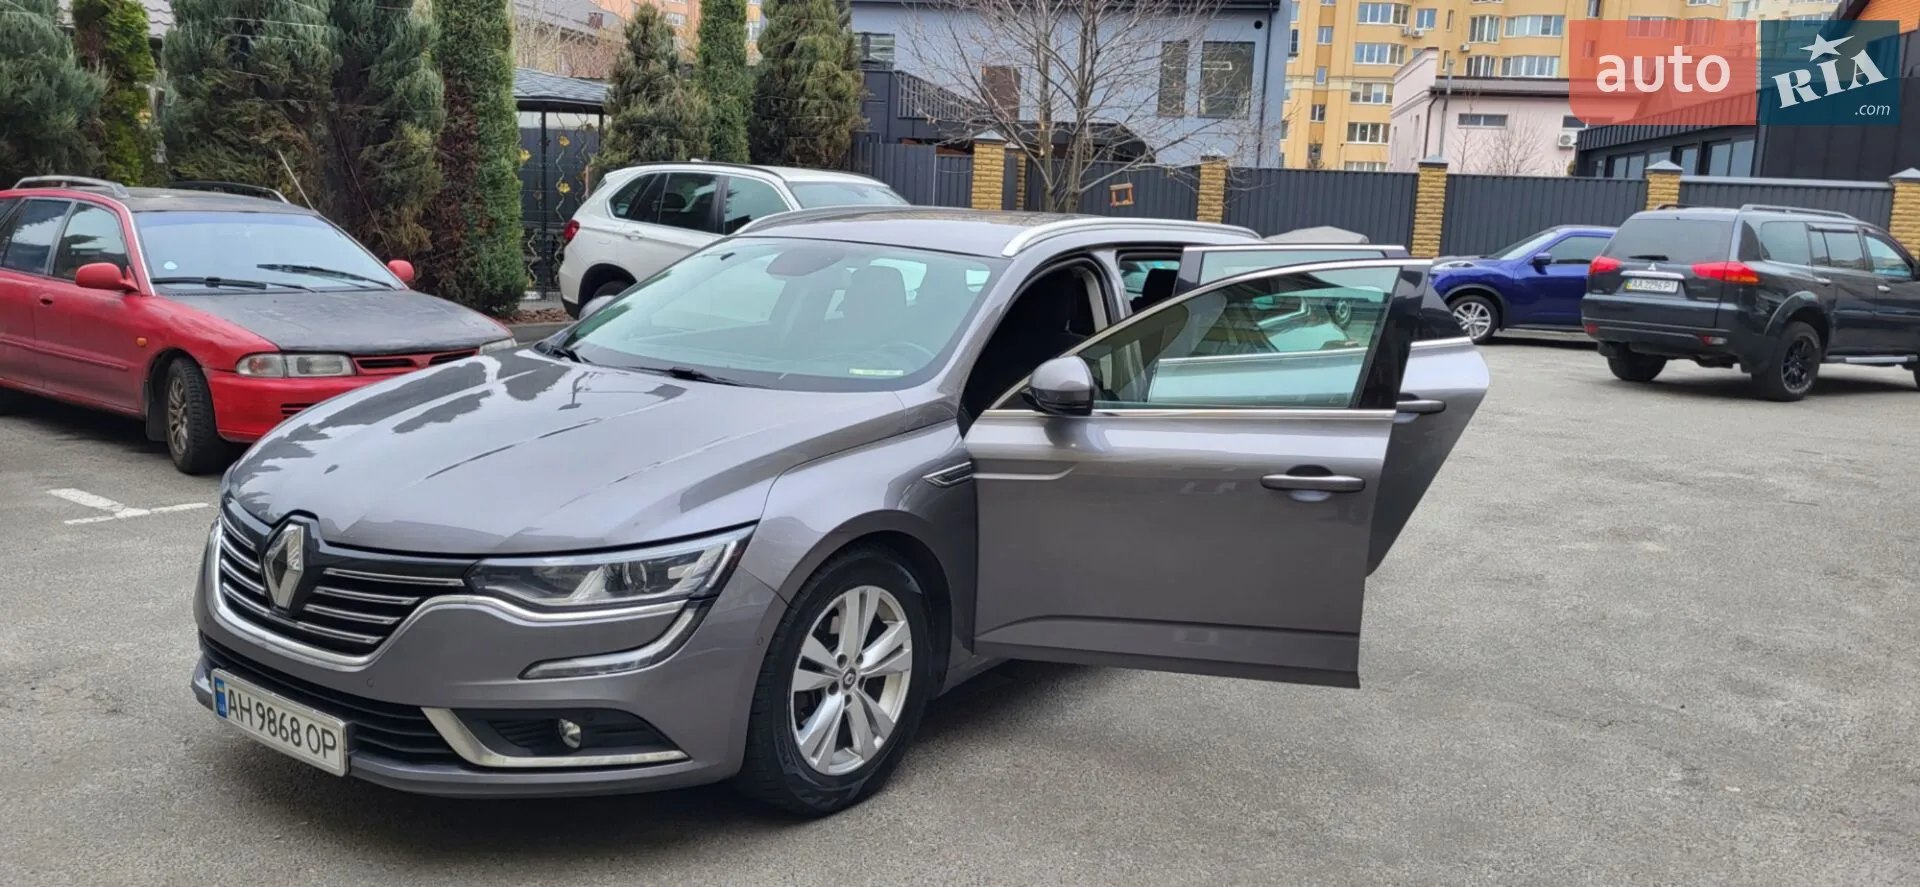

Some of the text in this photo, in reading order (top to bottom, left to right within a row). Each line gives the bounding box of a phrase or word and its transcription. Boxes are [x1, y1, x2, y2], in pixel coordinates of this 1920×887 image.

[228, 689, 337, 759] AH 9868 OP
